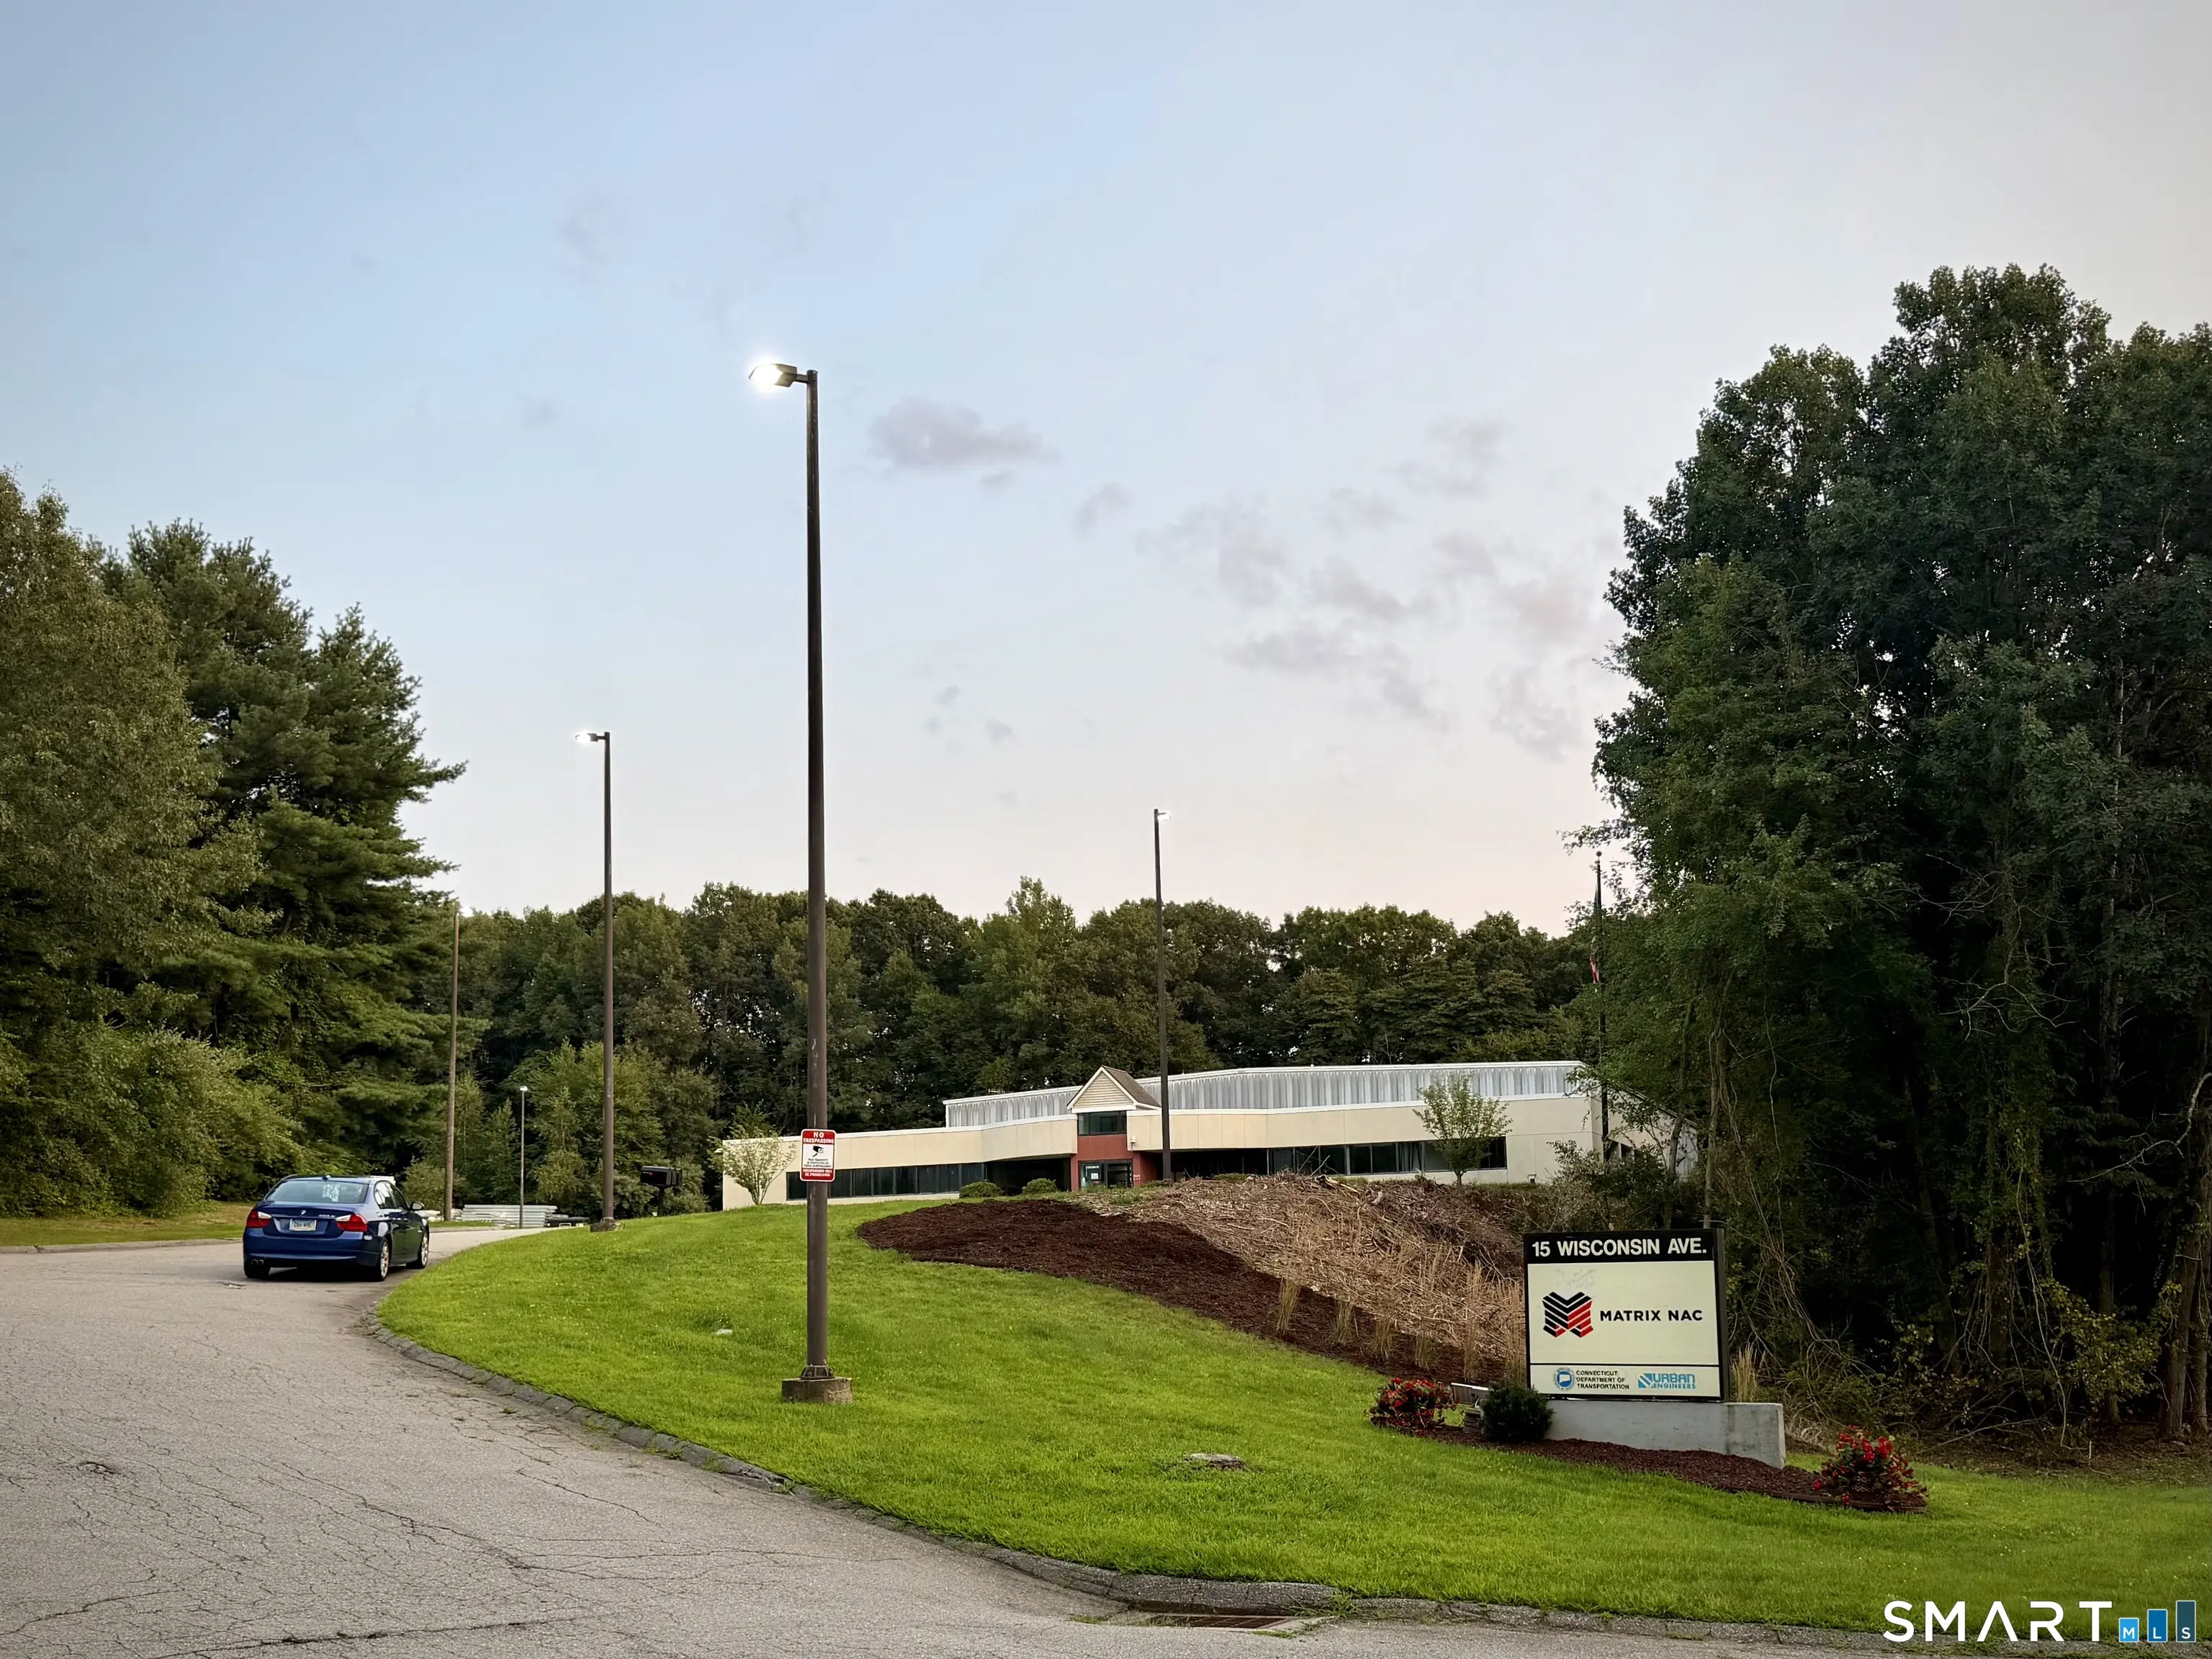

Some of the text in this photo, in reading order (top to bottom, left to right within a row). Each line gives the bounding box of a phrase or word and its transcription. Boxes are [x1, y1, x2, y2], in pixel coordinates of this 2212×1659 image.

[1532, 1238, 1707, 1257] 15 WISCONSIN AVE.
[1600, 1310, 1703, 1321] MATRIX NAC
[1653, 1373, 1695, 1383] URBAN
